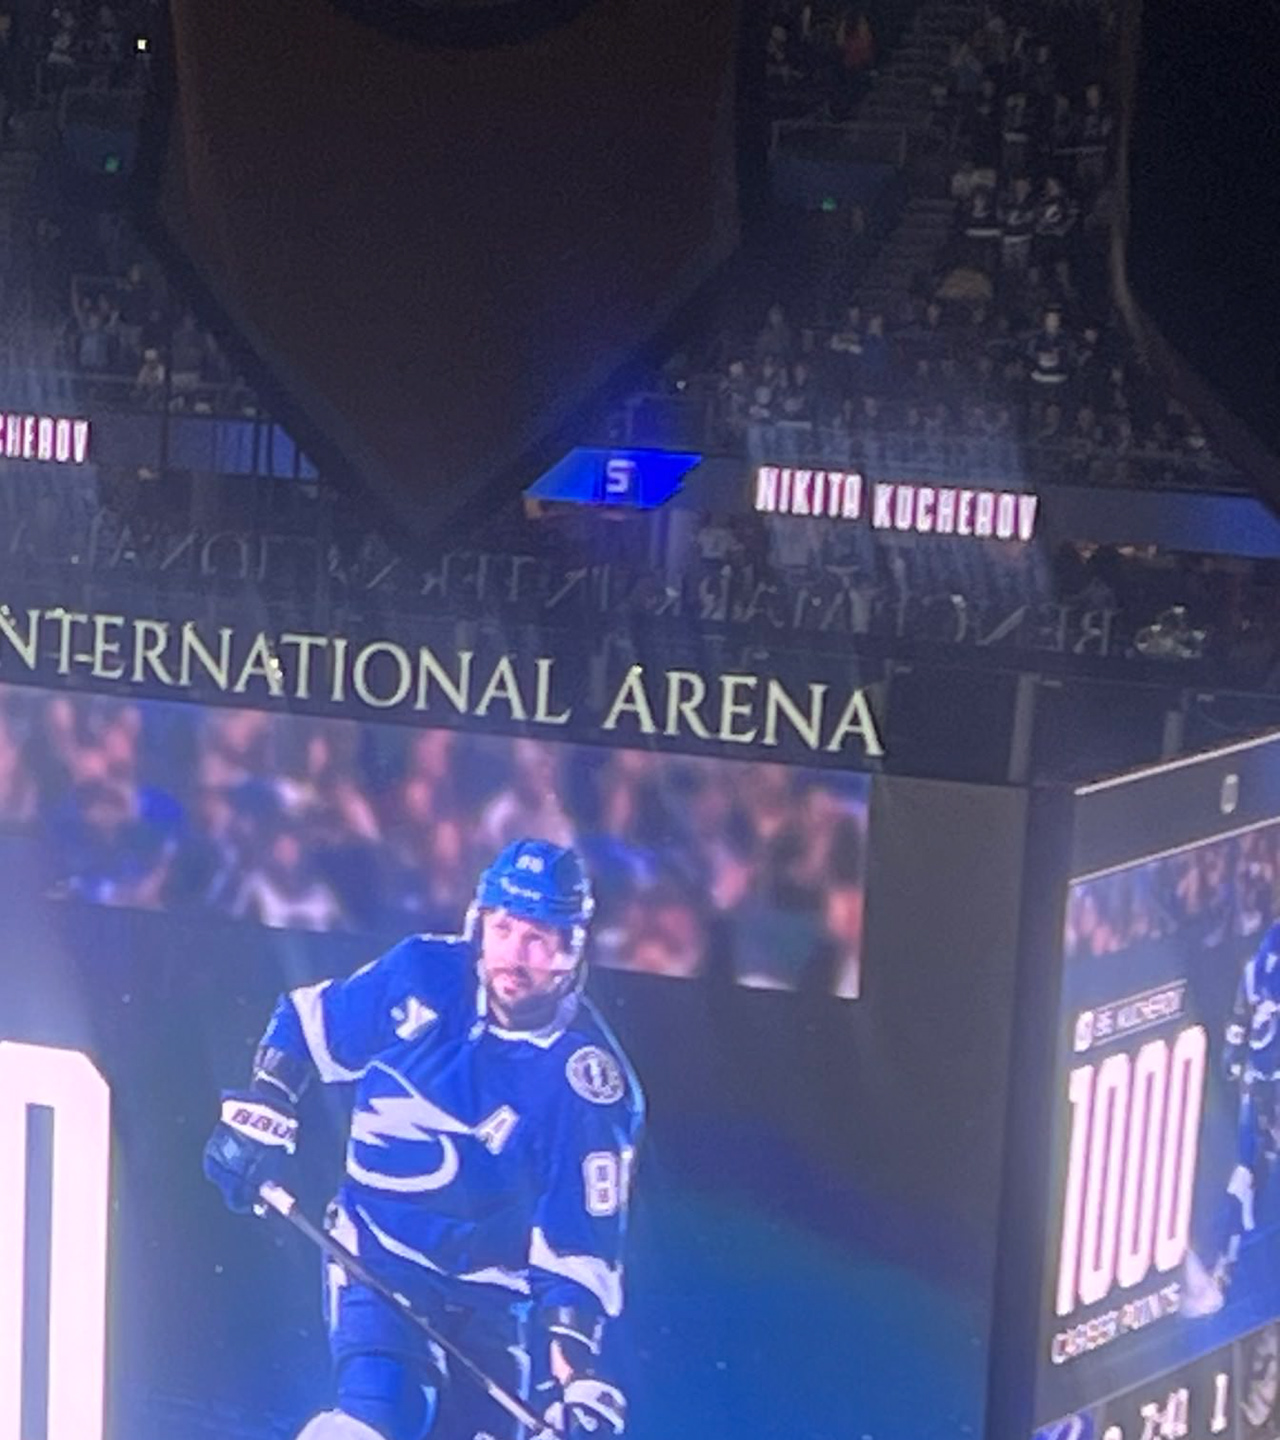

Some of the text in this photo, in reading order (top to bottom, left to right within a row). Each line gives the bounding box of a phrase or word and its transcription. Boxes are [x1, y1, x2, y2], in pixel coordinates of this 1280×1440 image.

[755, 466, 1037, 541] NIKITA KUCHEROV
[602, 664, 885, 756] ARENA
[1055, 1025, 1208, 1317] 1000
